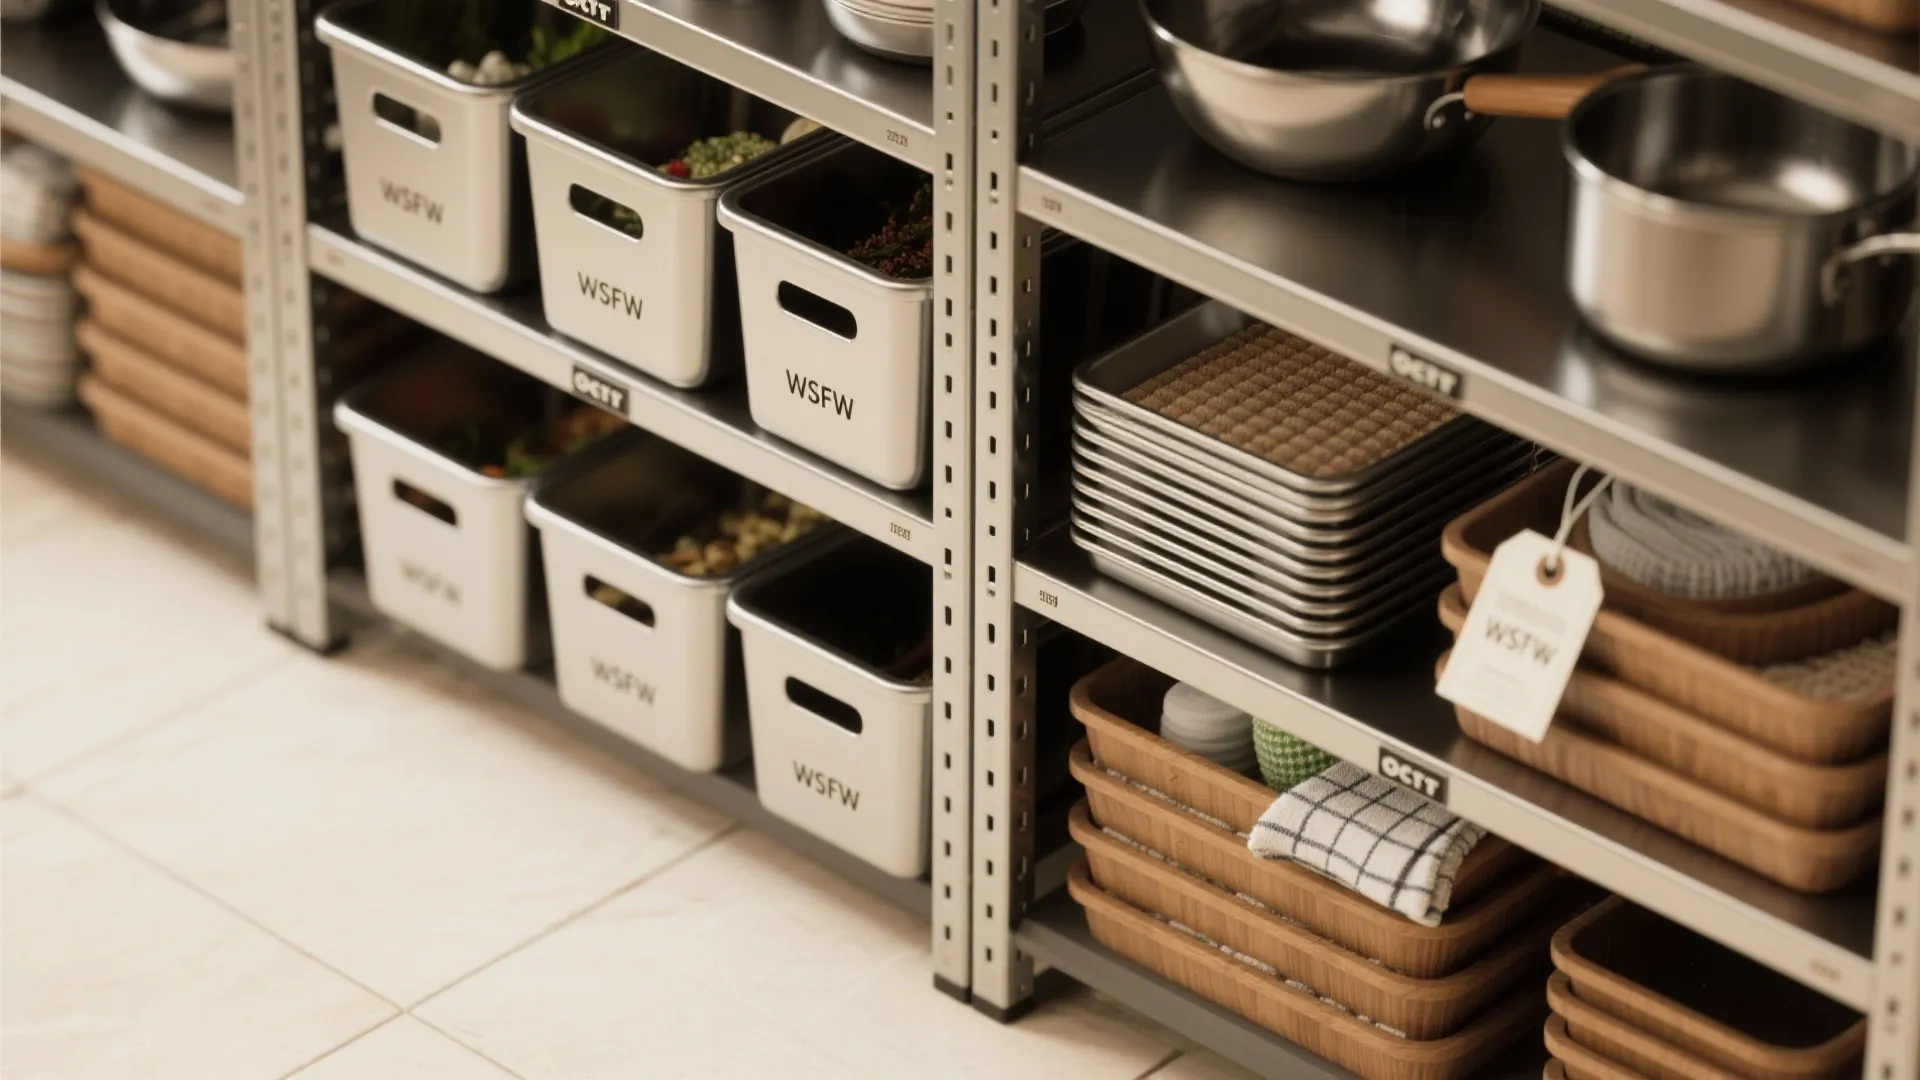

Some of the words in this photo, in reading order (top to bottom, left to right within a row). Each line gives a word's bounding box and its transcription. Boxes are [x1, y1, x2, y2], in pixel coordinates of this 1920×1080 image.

[379, 177, 444, 225] WSFW
[577, 271, 643, 320] WSFW
[786, 368, 854, 420] WSFW
[792, 760, 860, 811] WSFW
